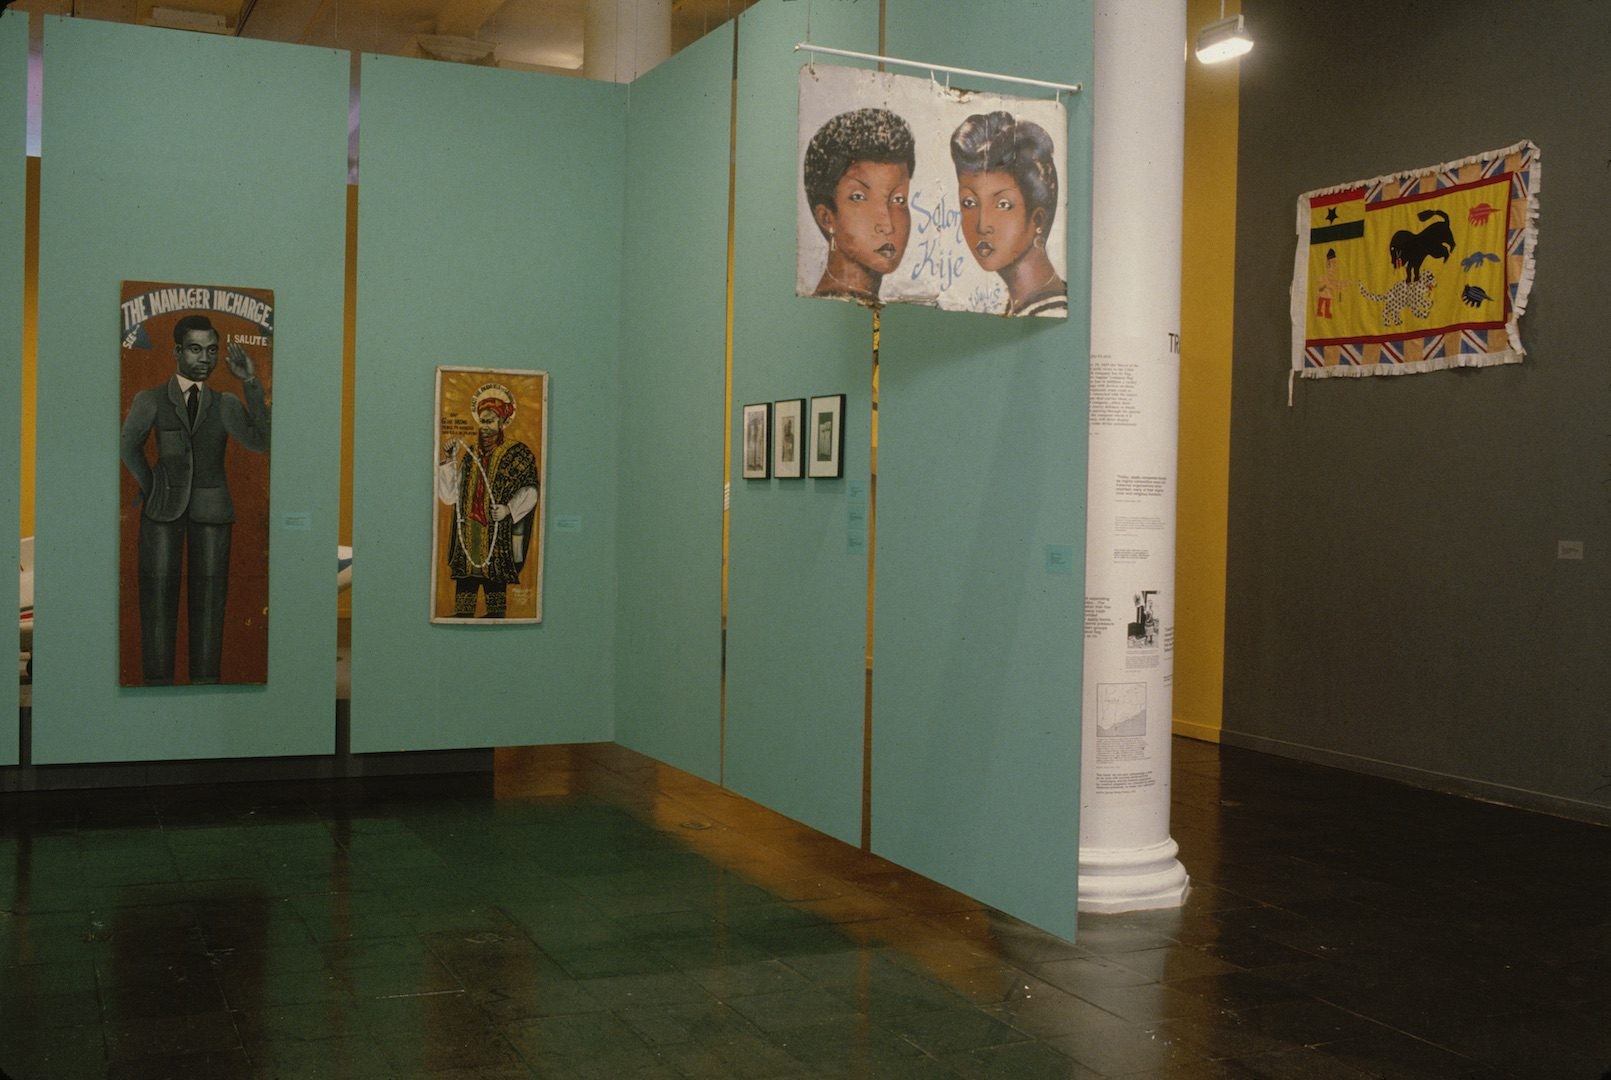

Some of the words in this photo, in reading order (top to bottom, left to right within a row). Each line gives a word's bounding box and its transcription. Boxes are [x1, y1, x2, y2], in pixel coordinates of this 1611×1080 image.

[911, 191, 963, 244] Salon
[911, 239, 964, 292] Kije
[121, 295, 148, 331] THE
[149, 287, 210, 316] MANAGER
[226, 333, 231, 344] I
[233, 334, 269, 347] SALUTE
